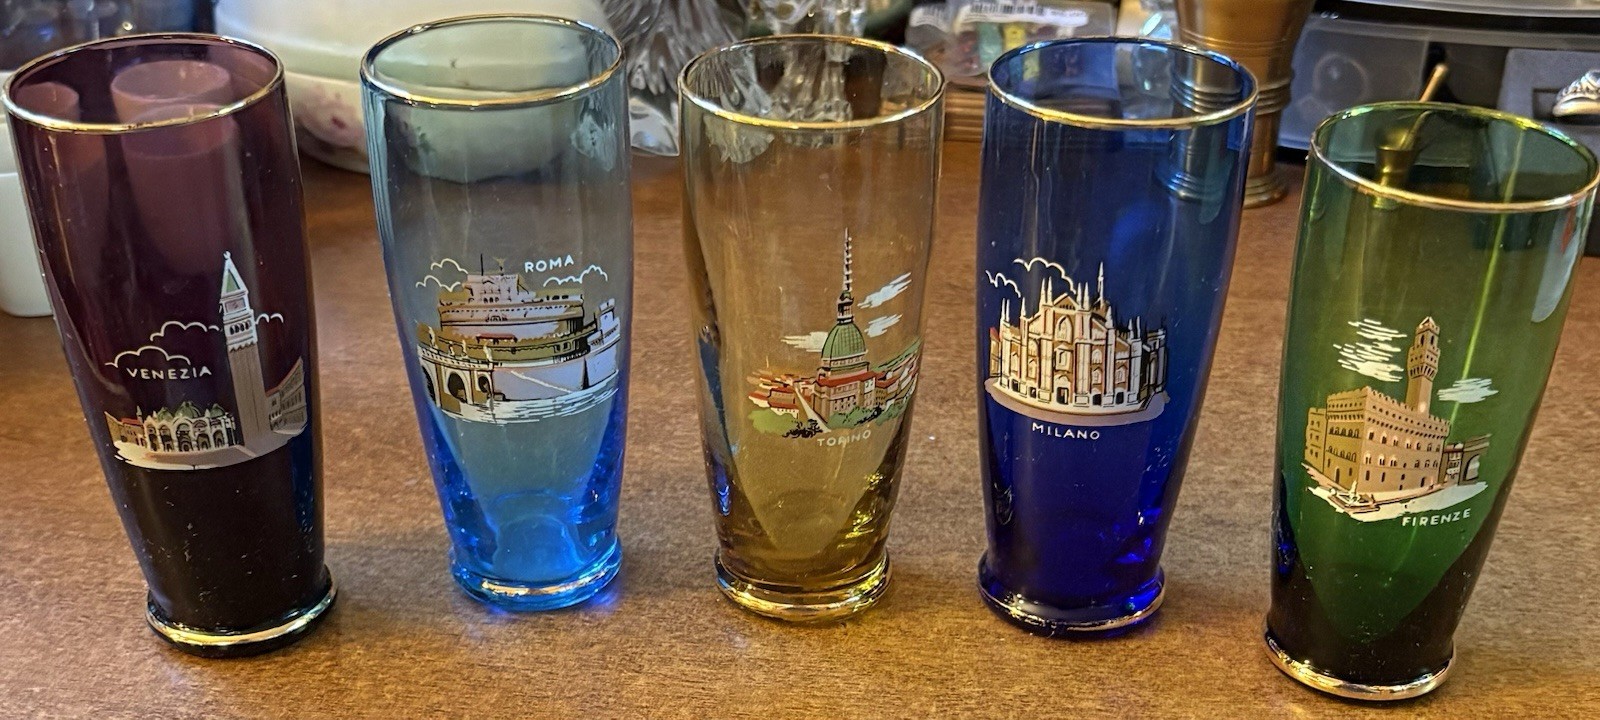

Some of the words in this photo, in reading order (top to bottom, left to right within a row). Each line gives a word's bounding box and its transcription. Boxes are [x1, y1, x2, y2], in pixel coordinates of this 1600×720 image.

[524, 254, 575, 273] ROMA
[126, 366, 212, 380] VENEZIA
[816, 429, 872, 447] TORINO
[1032, 422, 1101, 440] MILANO
[1402, 508, 1471, 527] FIRENZE
